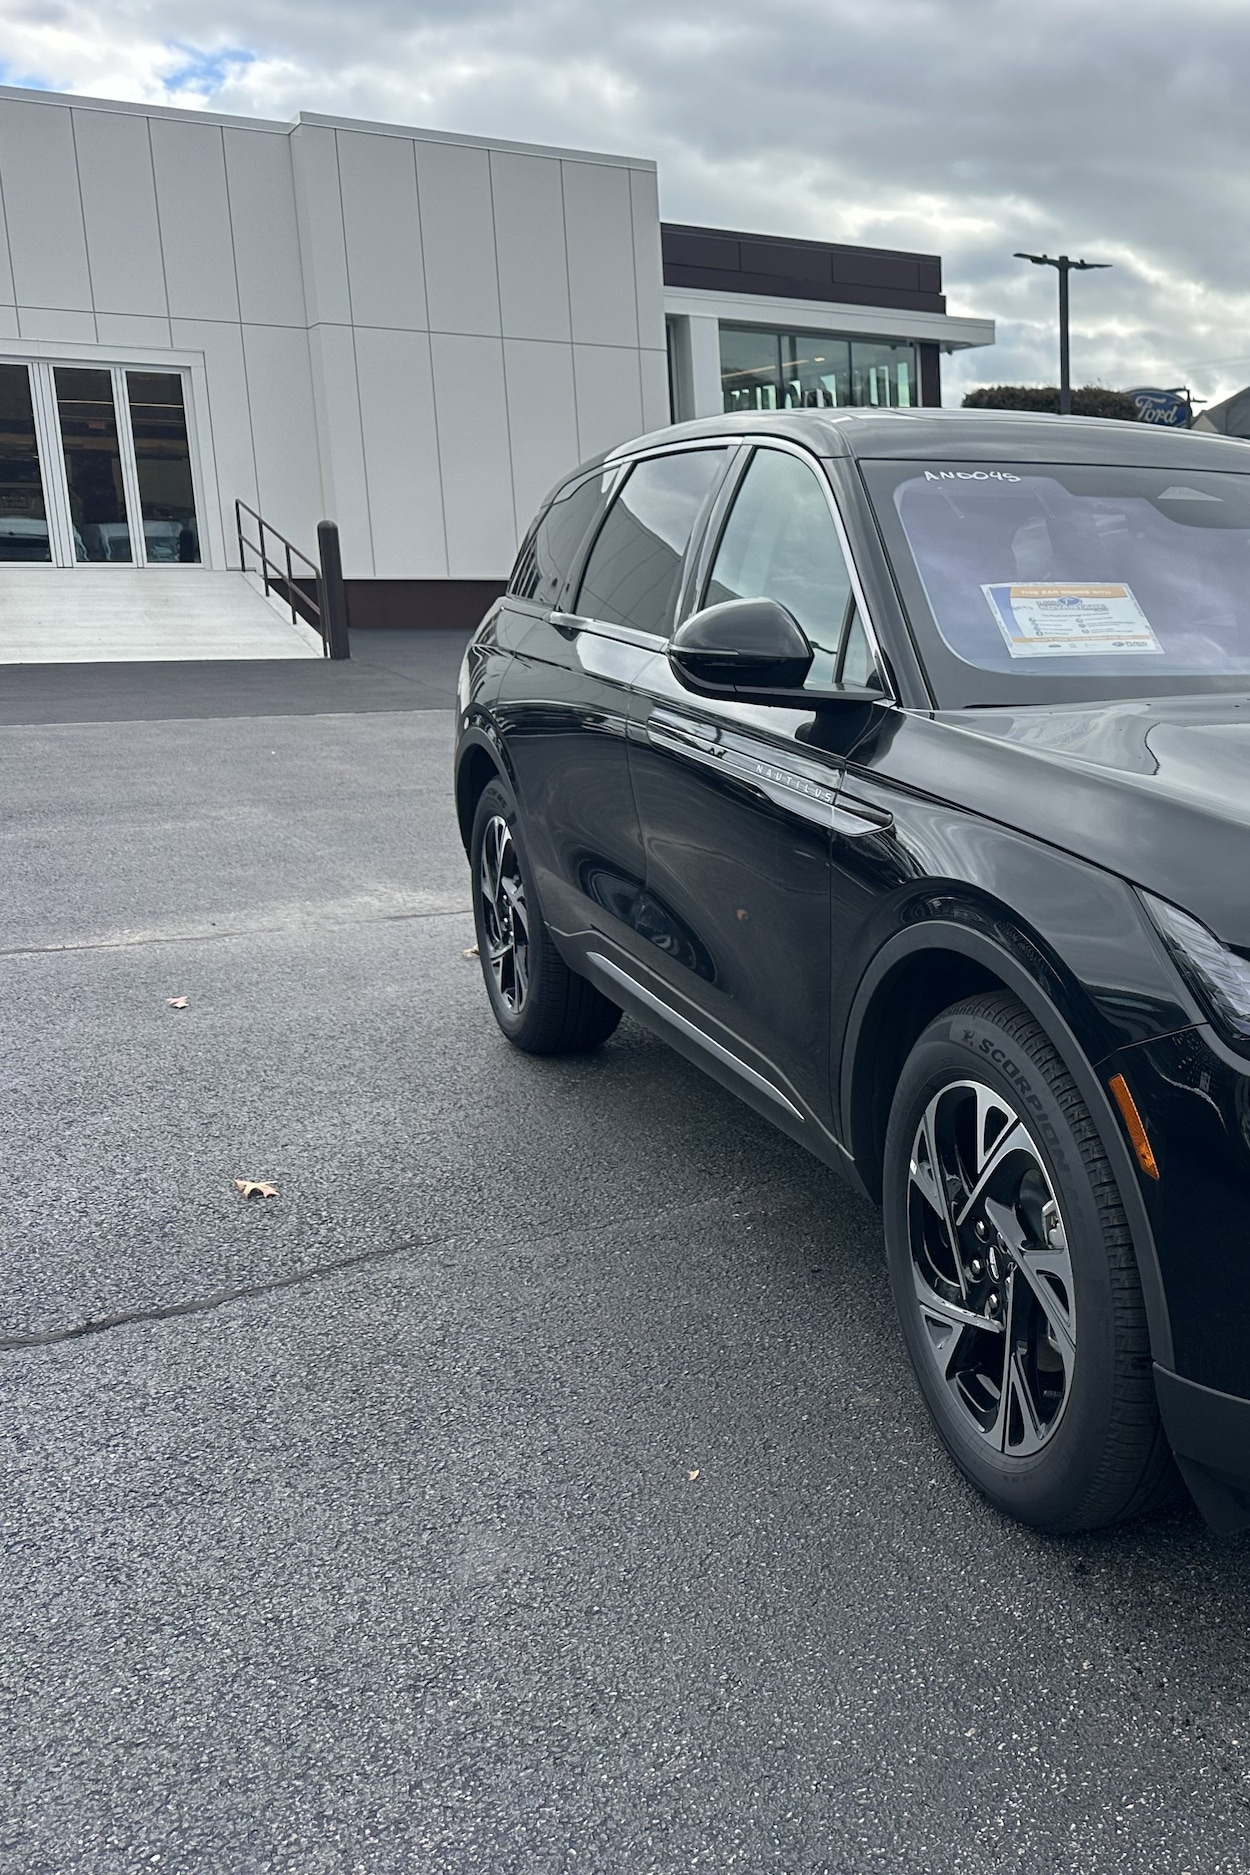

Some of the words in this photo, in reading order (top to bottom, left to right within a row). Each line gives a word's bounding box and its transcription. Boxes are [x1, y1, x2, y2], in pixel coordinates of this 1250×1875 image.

[1135, 395, 1178, 424] Ford
[755, 764, 832, 802] NAUTILUS
[979, 1037, 1071, 1173] SCORPION
